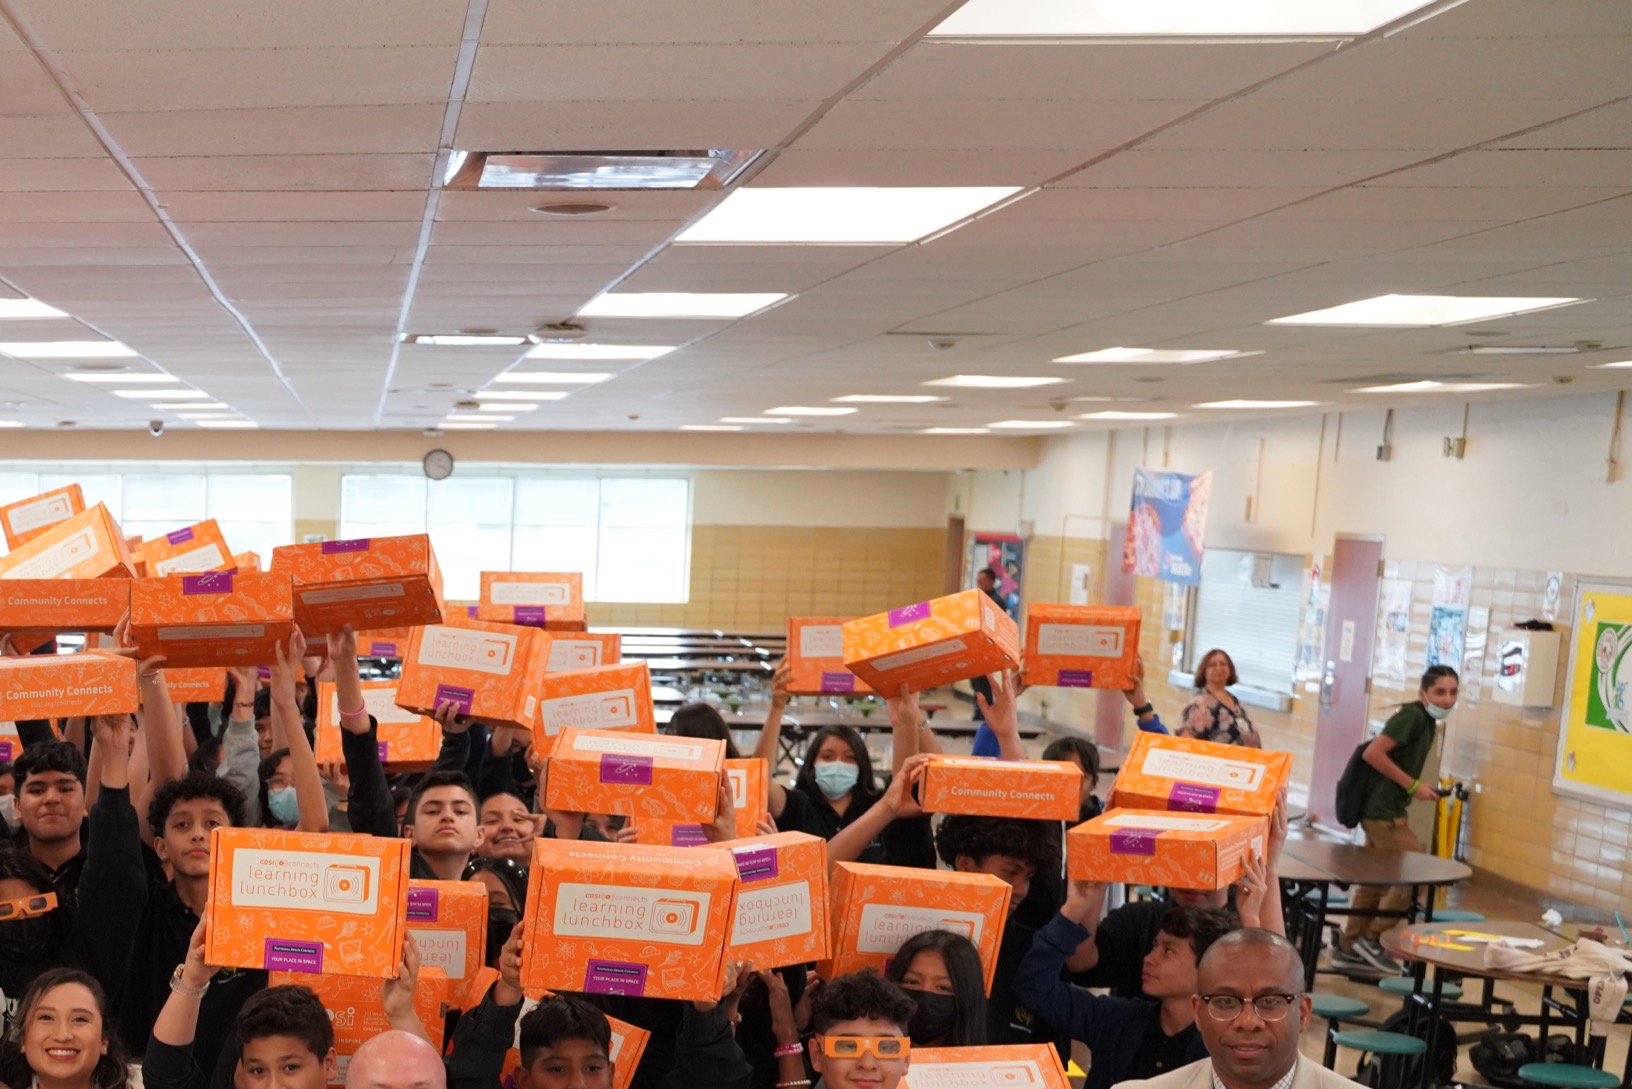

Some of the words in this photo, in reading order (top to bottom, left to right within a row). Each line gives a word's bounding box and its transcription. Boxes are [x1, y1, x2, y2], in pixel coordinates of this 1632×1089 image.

[8, 596, 62, 607] Community
[64, 596, 107, 604] Connects
[7, 688, 64, 700] Community
[67, 685, 113, 696] Connects
[951, 786, 1007, 800] Community
[1010, 790, 1054, 800] Connects
[249, 865, 319, 886] learning
[240, 881, 318, 899] lunchbox
[573, 899, 646, 919] learning
[739, 893, 803, 911] lunchbox
[563, 912, 643, 930] lunchbox
[739, 907, 797, 925] learning
